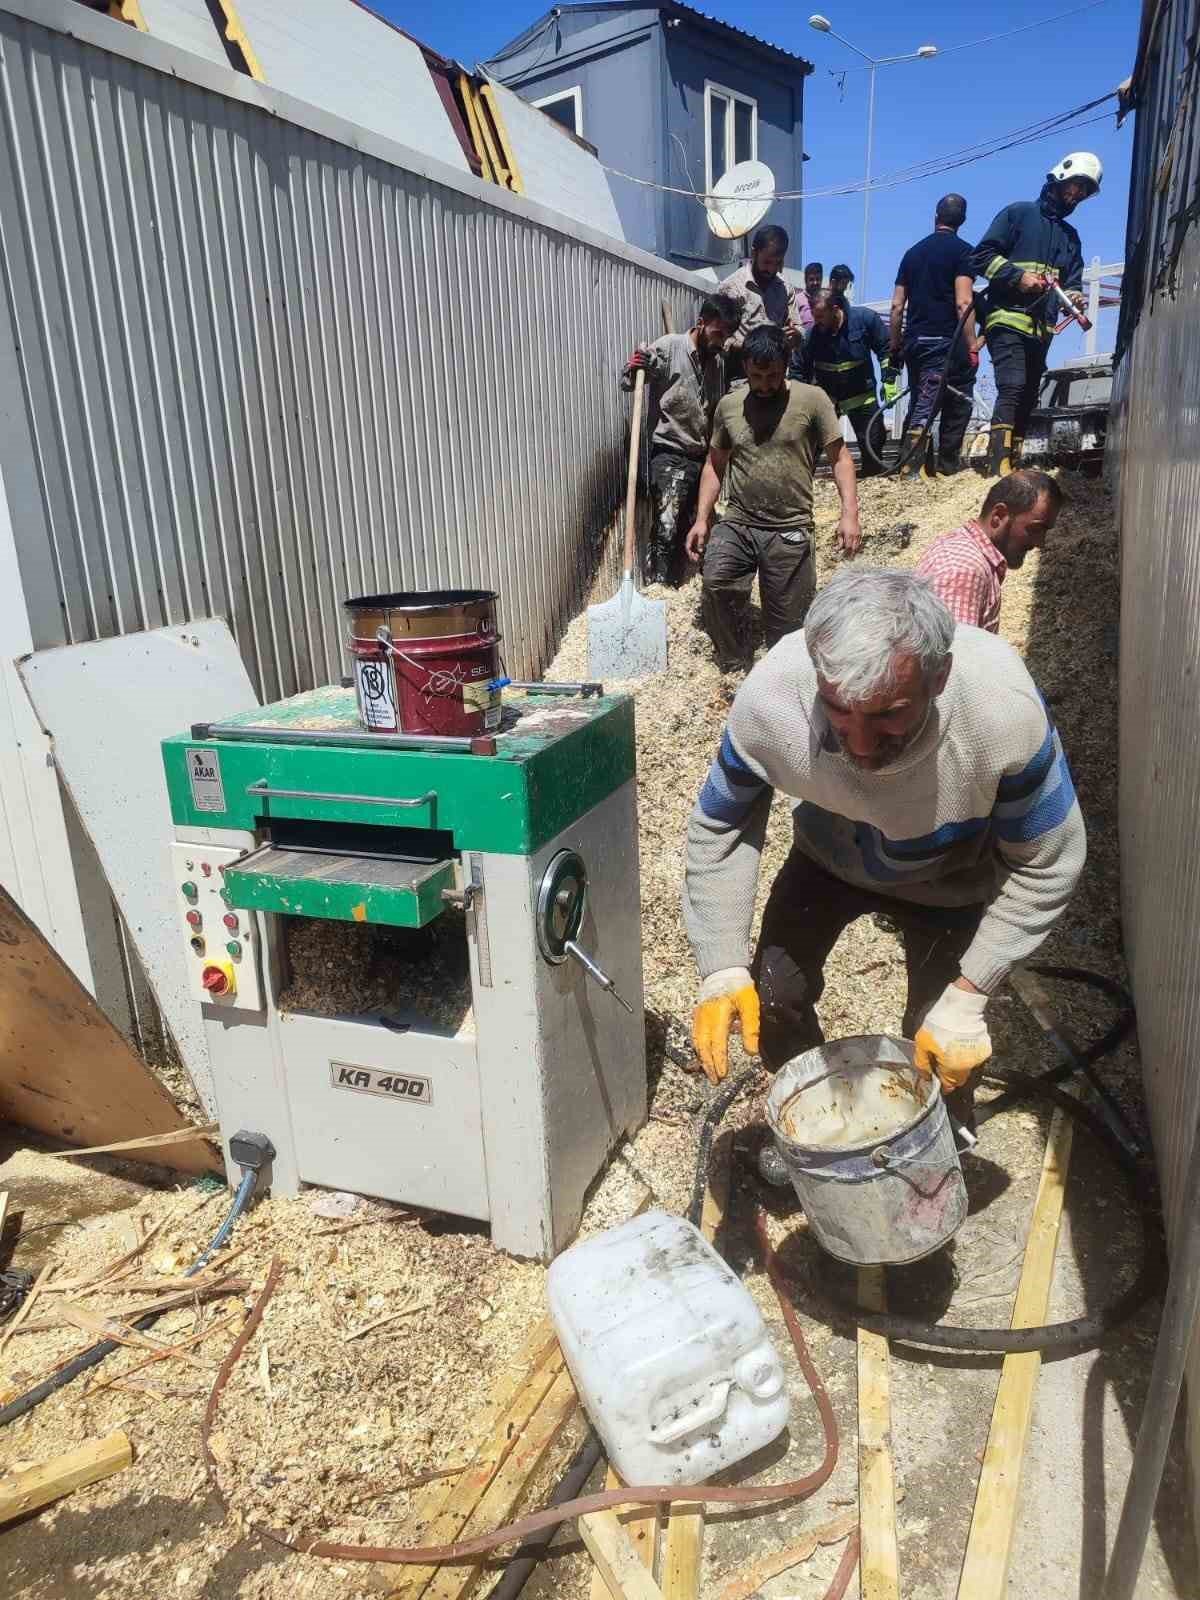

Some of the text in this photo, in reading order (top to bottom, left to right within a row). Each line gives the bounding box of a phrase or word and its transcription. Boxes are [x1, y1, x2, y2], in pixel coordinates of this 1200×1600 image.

[194, 767, 215, 777] AKAR
[338, 1068, 425, 1096] KA 400
